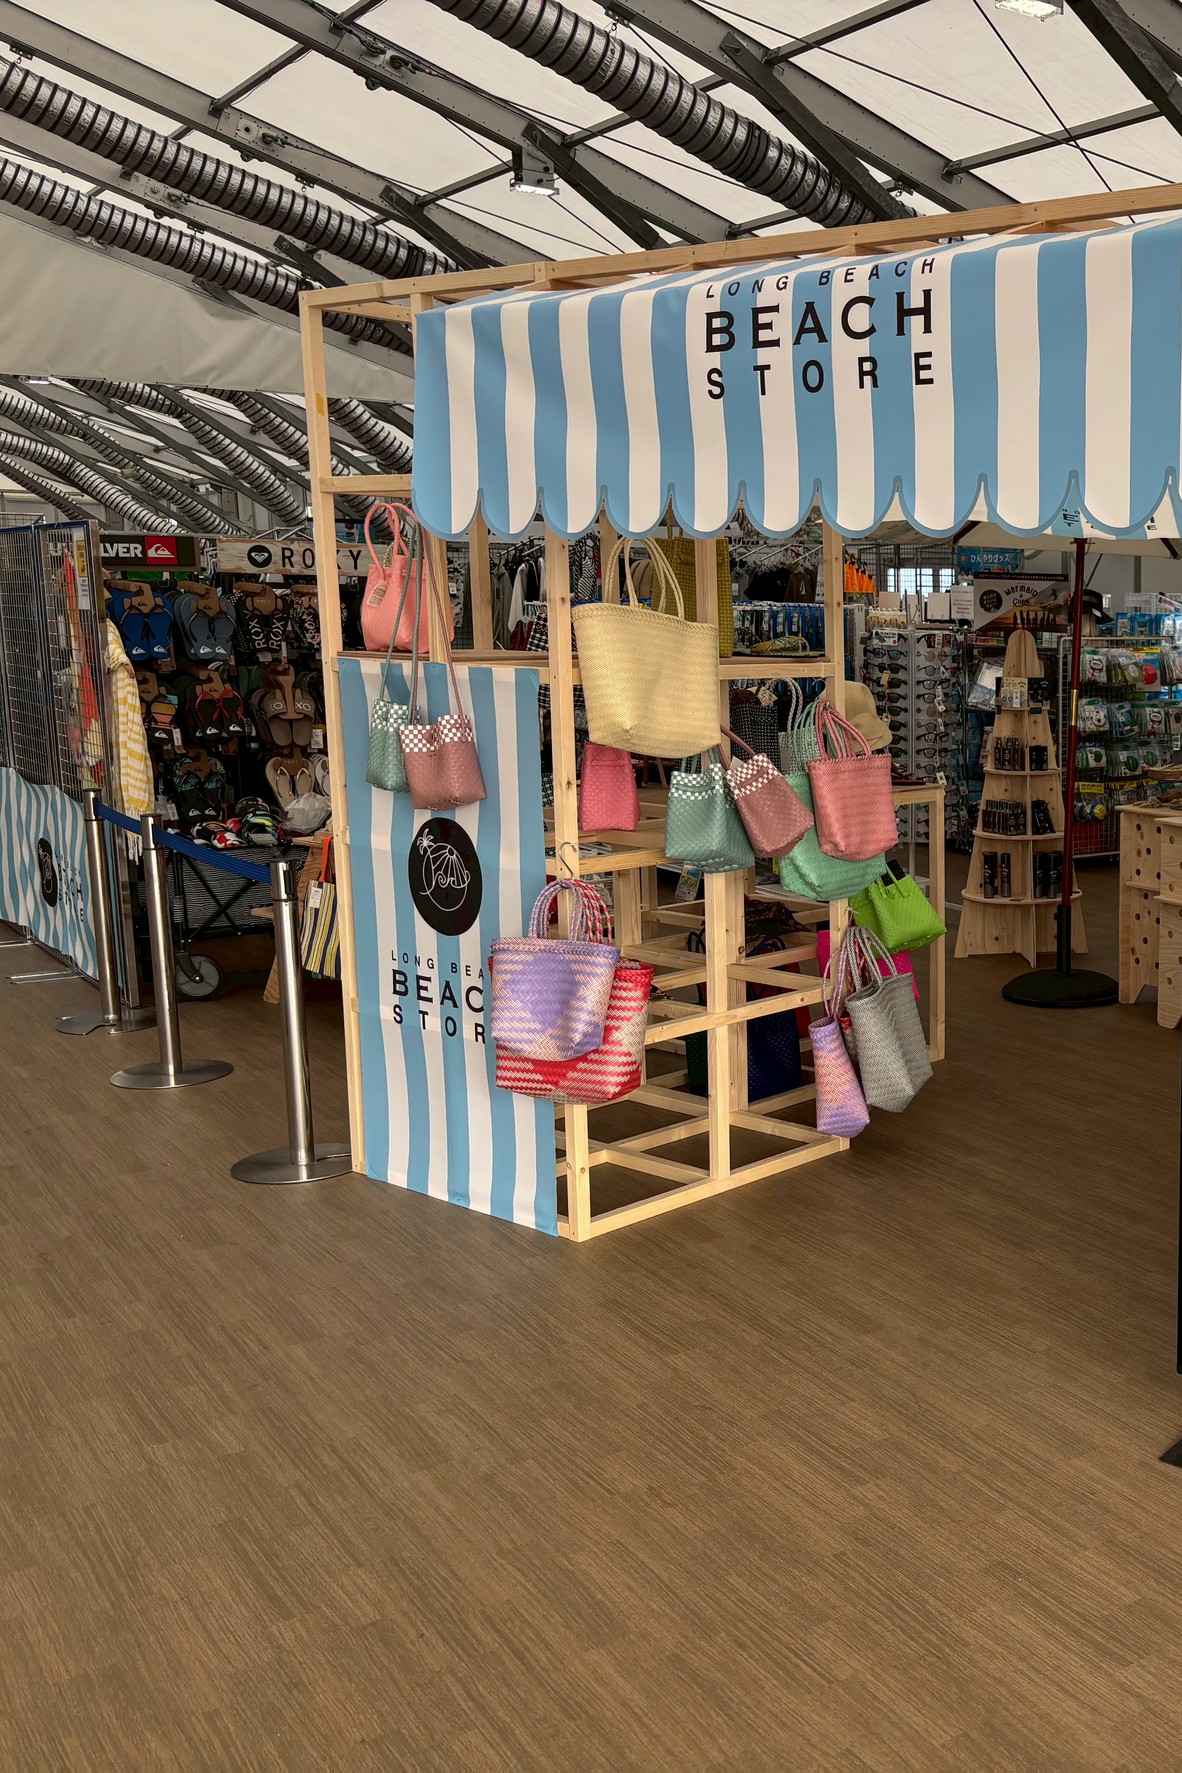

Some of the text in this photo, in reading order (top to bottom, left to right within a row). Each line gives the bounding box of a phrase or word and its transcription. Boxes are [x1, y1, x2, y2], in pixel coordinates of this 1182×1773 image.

[705, 258, 936, 299] LONG BEACH
[704, 288, 933, 354] BEACH
[706, 351, 934, 400] STORE
[281, 547, 362, 570] ROY
[391, 950, 485, 980] LONG BEA
[392, 968, 485, 1013] BEAC
[393, 1004, 486, 1044] STOR
